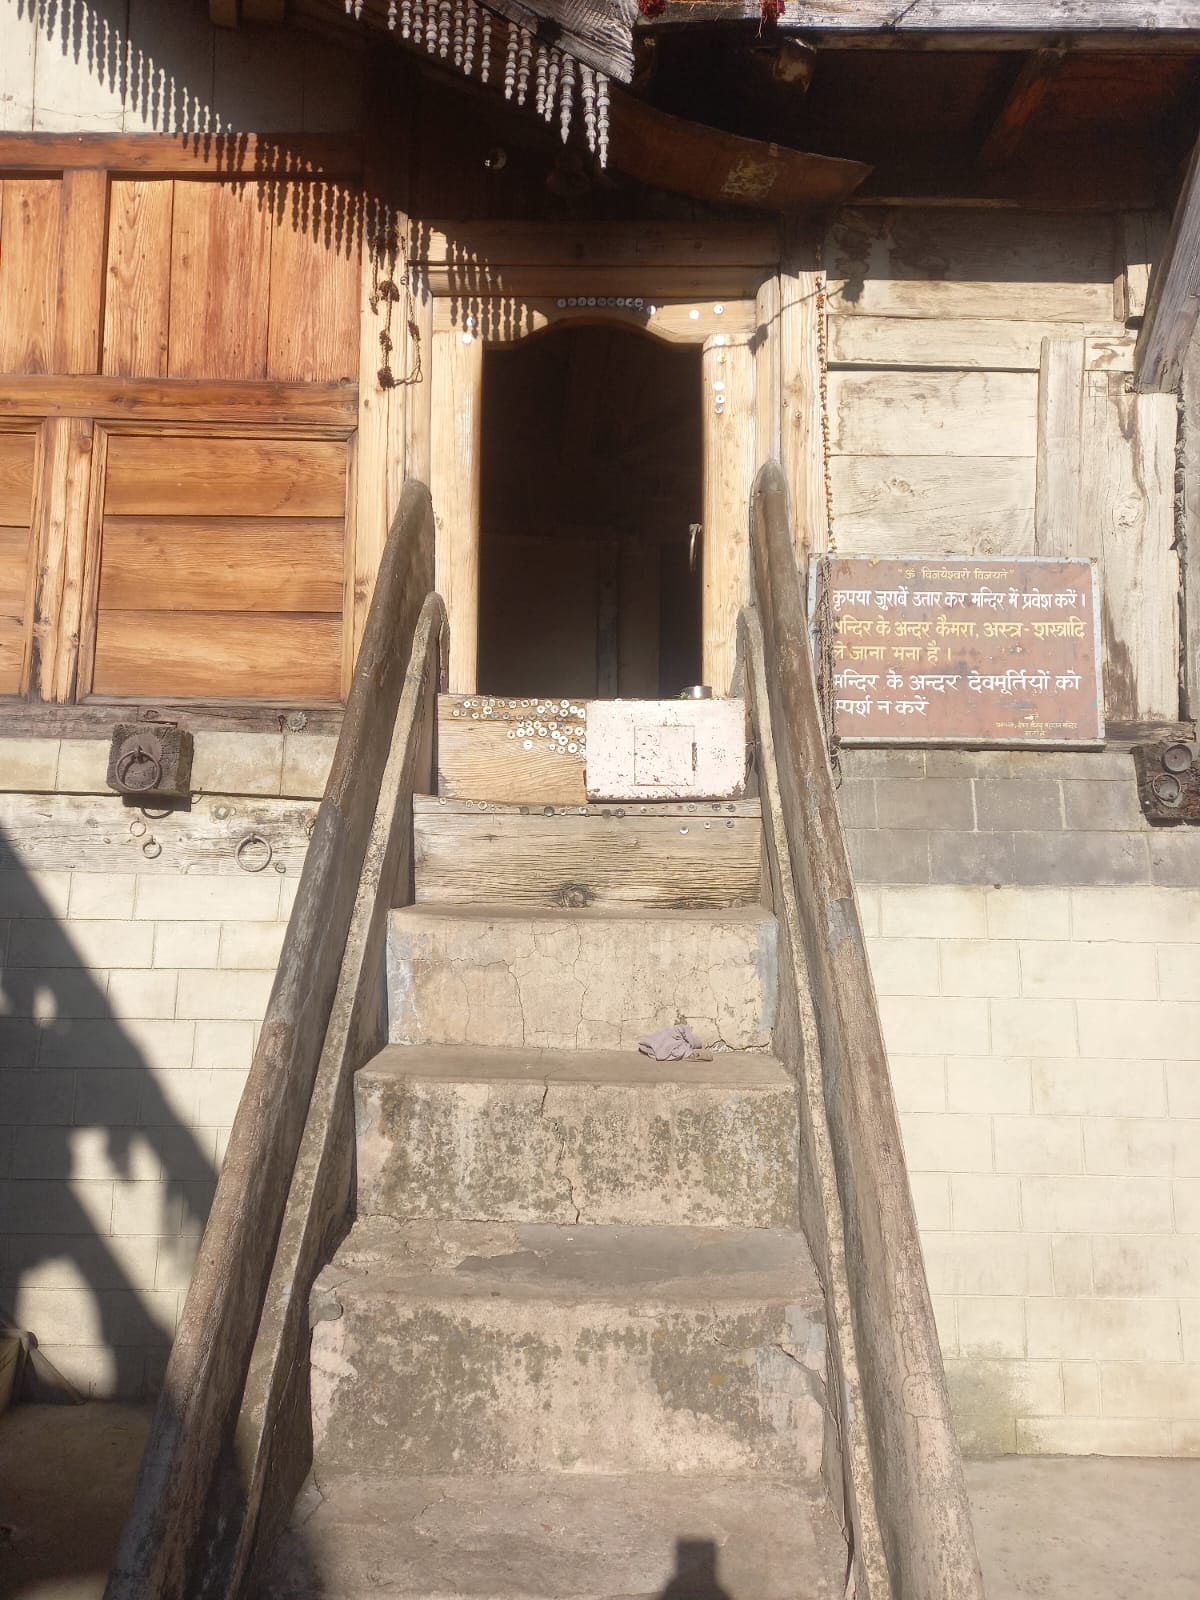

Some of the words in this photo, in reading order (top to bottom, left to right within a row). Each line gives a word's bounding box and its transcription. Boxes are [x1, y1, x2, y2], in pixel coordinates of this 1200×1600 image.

[832, 590, 872, 612] कृपया
[912, 591, 943, 608] उतार
[944, 591, 968, 609] कर
[971, 586, 1006, 610] मन्दिर
[1008, 587, 1020, 609] में
[1021, 588, 1053, 612] प्रवेश
[876, 615, 891, 637] के
[894, 621, 933, 639] अन्दर
[849, 645, 886, 661] जाना
[891, 646, 922, 661] मना
[834, 668, 880, 692] मन्दिर
[886, 667, 903, 690] के
[909, 674, 962, 693] अन्दर
[1055, 668, 1082, 690] को
[876, 700, 892, 715] न
[895, 694, 930, 716] करें
